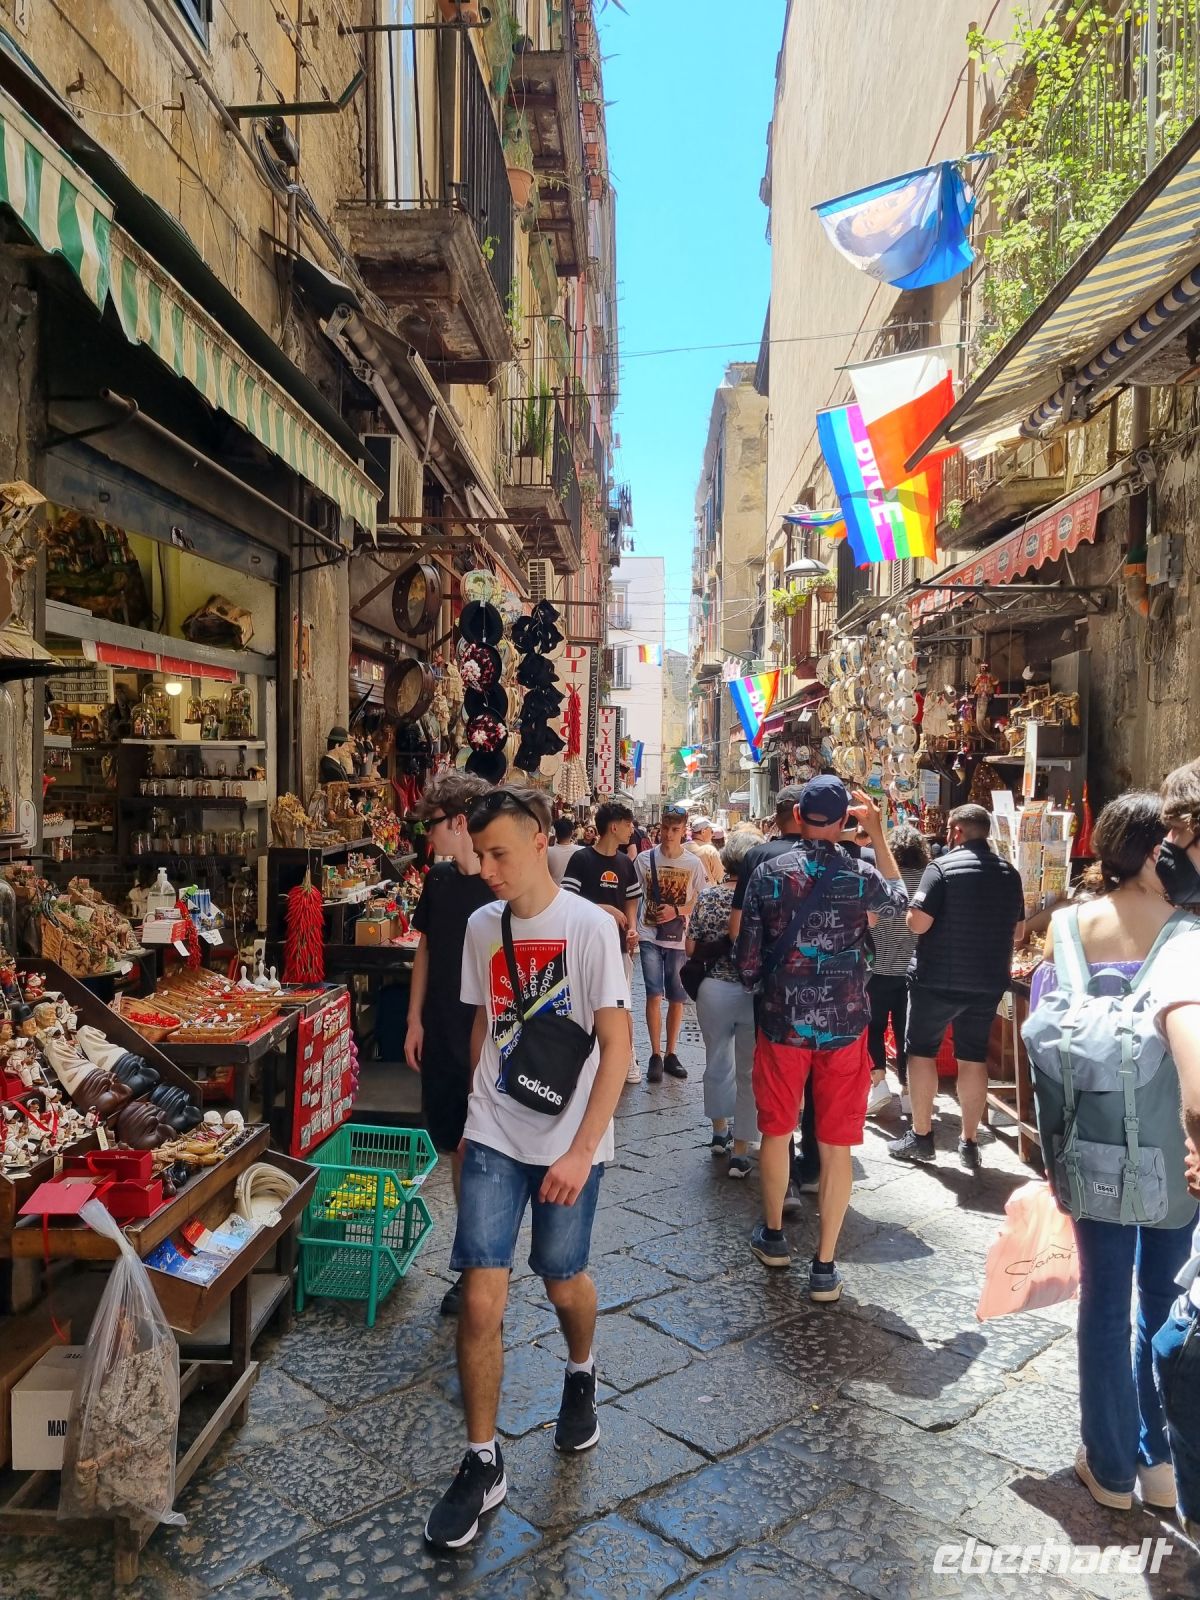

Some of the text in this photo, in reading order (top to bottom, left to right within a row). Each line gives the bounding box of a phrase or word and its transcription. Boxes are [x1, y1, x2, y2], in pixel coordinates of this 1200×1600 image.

[588, 692, 597, 742] GENNARO
[598, 708, 614, 793] DI VIRGILIO
[530, 957, 539, 997] adidas
[517, 1074, 563, 1106] adidas
[47, 1420, 68, 1436] MAD
